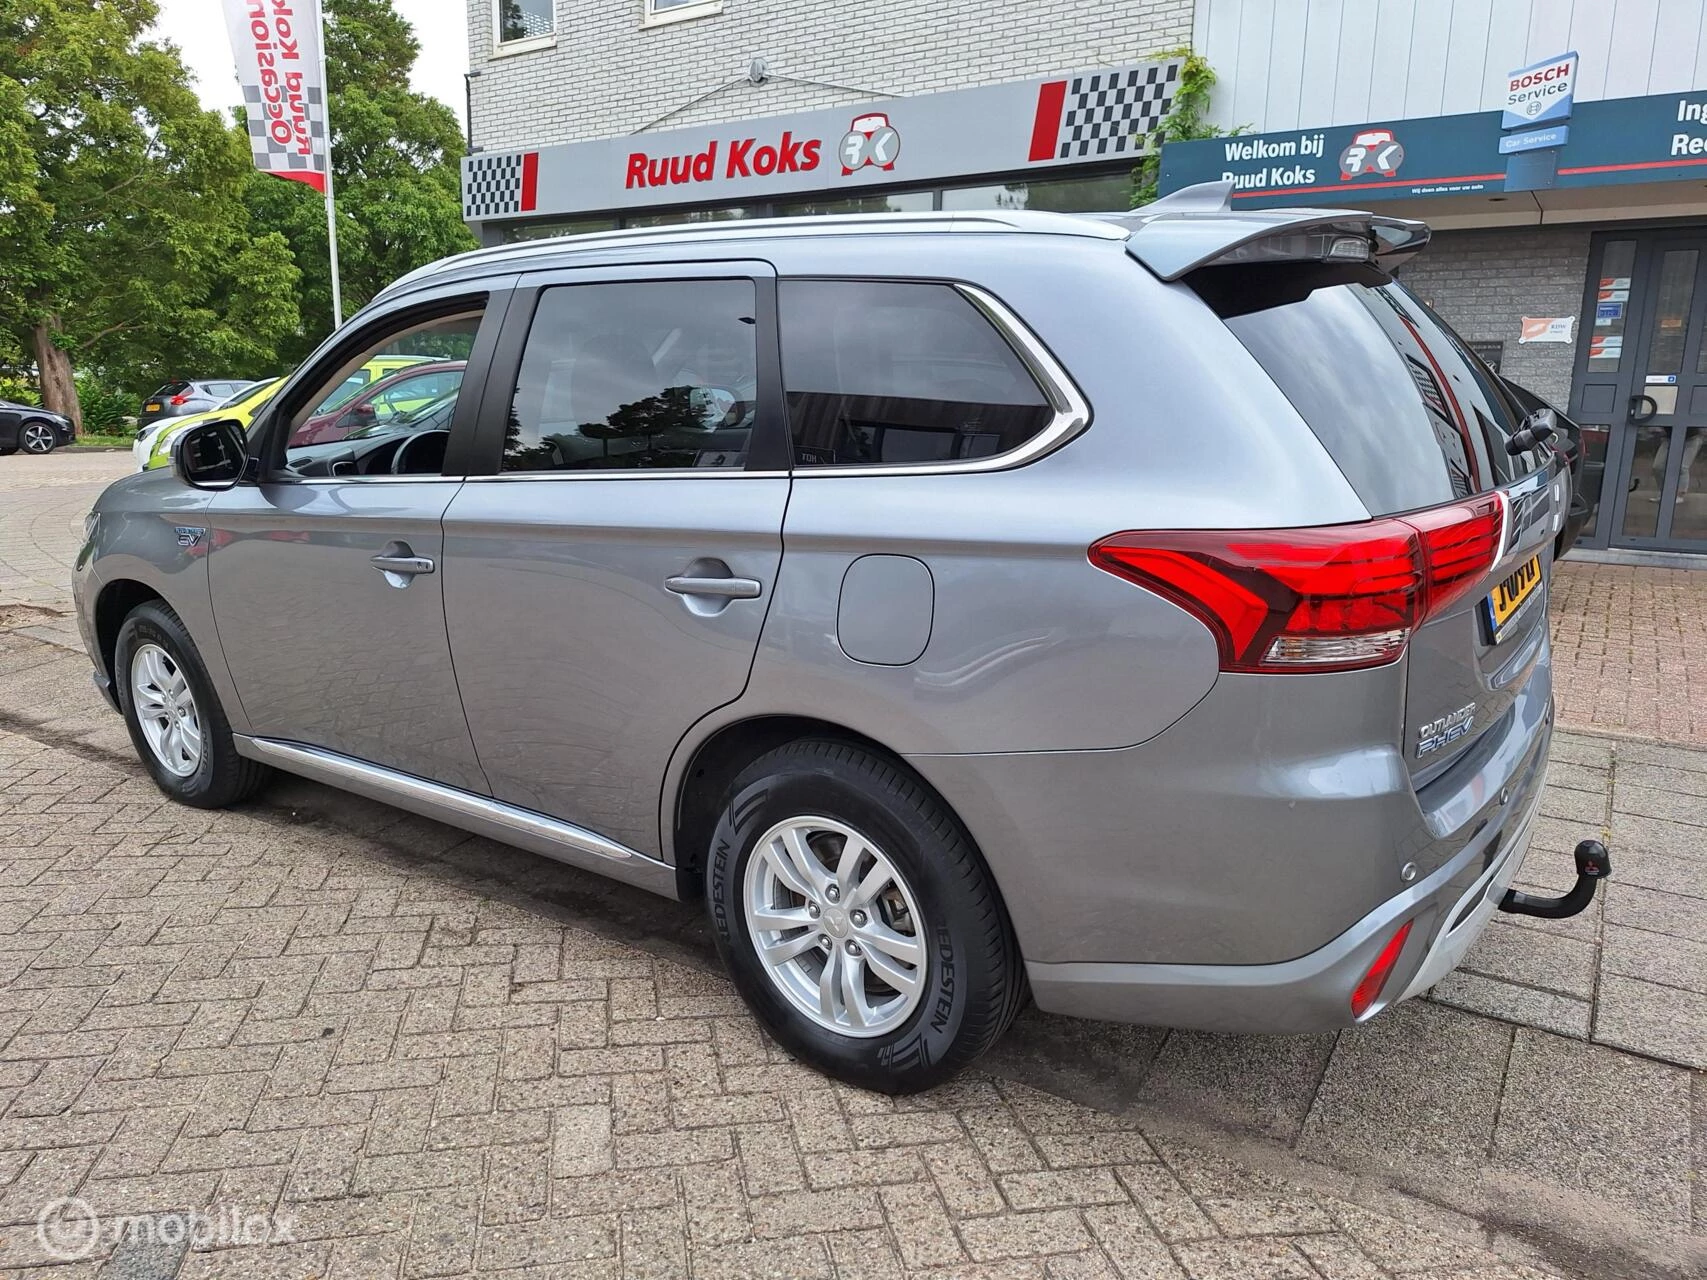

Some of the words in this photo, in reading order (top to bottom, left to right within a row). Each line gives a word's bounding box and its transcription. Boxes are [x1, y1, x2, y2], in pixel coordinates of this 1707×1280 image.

[1509, 63, 1570, 92] BOSCH
[1508, 81, 1568, 105] Service
[1225, 139, 1296, 162] Welkom
[1300, 134, 1325, 158] bij
[1505, 139, 1521, 148] Car
[1523, 132, 1557, 146] Service
[626, 140, 718, 190] Ruud
[726, 131, 822, 180] Koks
[1270, 165, 1316, 186] Koks
[1416, 715, 1474, 758] PHEV
